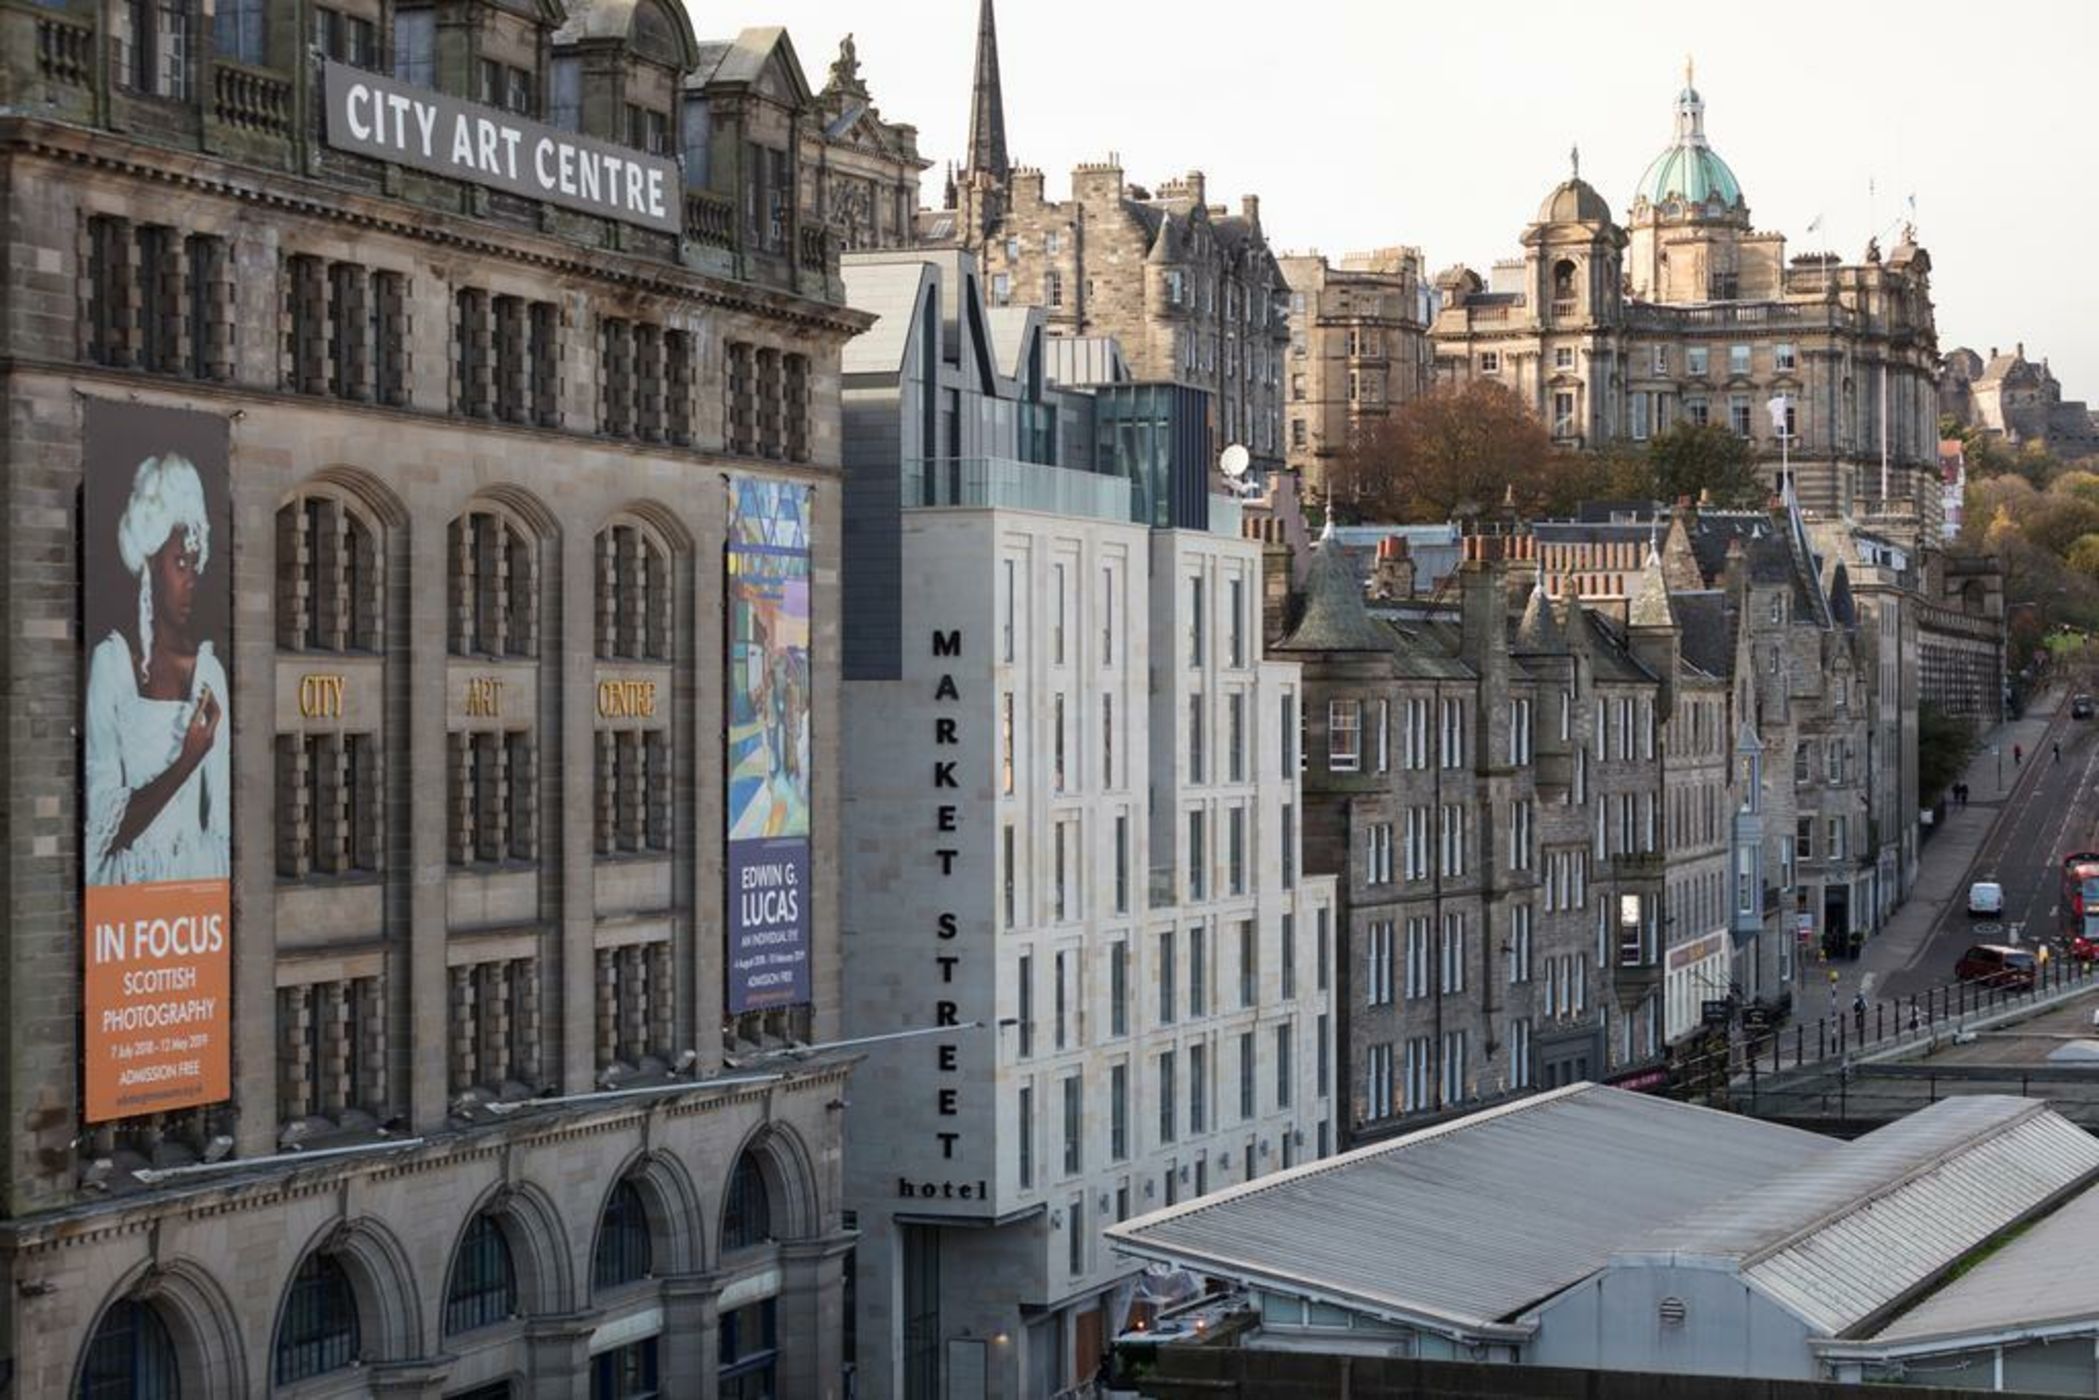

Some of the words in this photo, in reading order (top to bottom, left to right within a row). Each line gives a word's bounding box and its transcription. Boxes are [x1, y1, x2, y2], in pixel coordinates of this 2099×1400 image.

[346, 84, 437, 157] CITY
[452, 114, 521, 179] ART
[535, 137, 667, 218] CENTRE
[300, 674, 346, 719] CITY
[465, 677, 504, 717] ART
[598, 680, 656, 719] CENTRE
[932, 630, 961, 875] MARKET
[741, 864, 782, 889] EDWIN
[785, 862, 798, 885] G.
[741, 889, 799, 927] LUCAS
[95, 922, 126, 964] IN
[134, 913, 223, 960] FOCUS
[123, 967, 197, 995] SCOTTISH
[102, 997, 216, 1033] PHOTOGRAPHY
[936, 913, 960, 1159] STREET
[118, 1064, 177, 1086] ADMISSION
[178, 1059, 200, 1077] FREE
[898, 1177, 987, 1200] hotel
